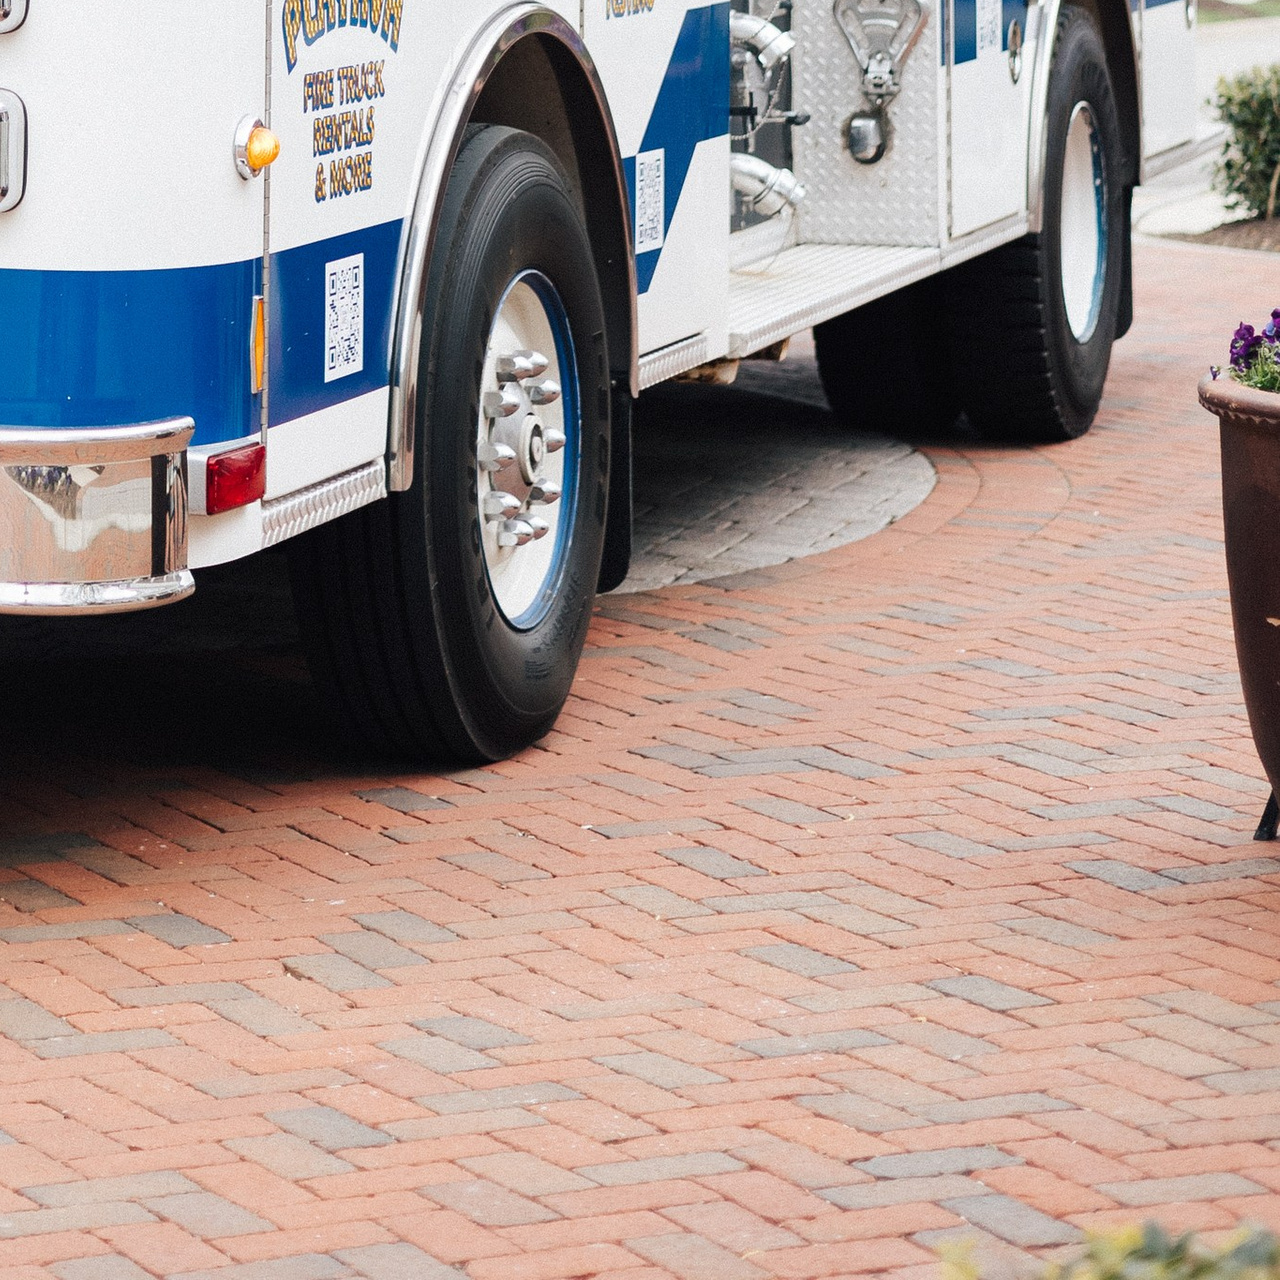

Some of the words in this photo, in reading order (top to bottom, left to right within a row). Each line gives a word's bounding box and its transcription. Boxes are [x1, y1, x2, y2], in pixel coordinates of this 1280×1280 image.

[303, 69, 334, 113] FIRE
[337, 59, 385, 106] TRUCK
[313, 106, 375, 158] RENTALS
[315, 162, 327, 203] &
[329, 152, 372, 199] MORE
